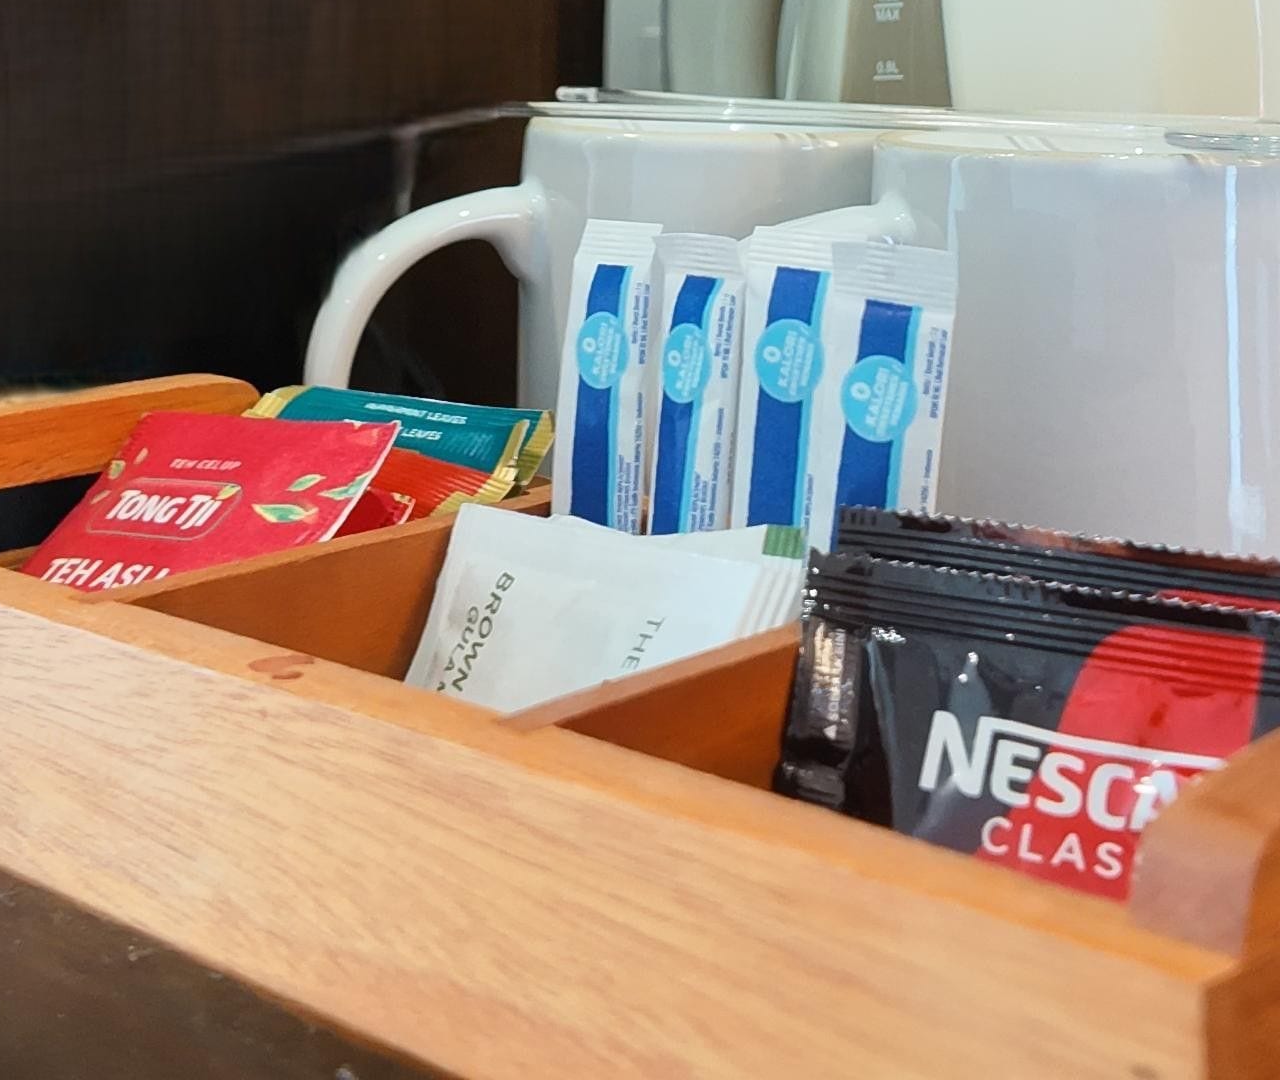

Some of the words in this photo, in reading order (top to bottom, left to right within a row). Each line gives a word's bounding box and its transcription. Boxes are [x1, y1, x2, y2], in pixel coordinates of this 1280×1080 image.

[105, 489, 187, 523] TONG
[175, 494, 224, 530] TJI
[39, 557, 103, 586] TEH
[444, 606, 478, 671] GULA
[452, 572, 515, 691] BROWN
[622, 617, 665, 669] THE
[918, 710, 1210, 833] NESCA
[981, 816, 1128, 880] CLAS
